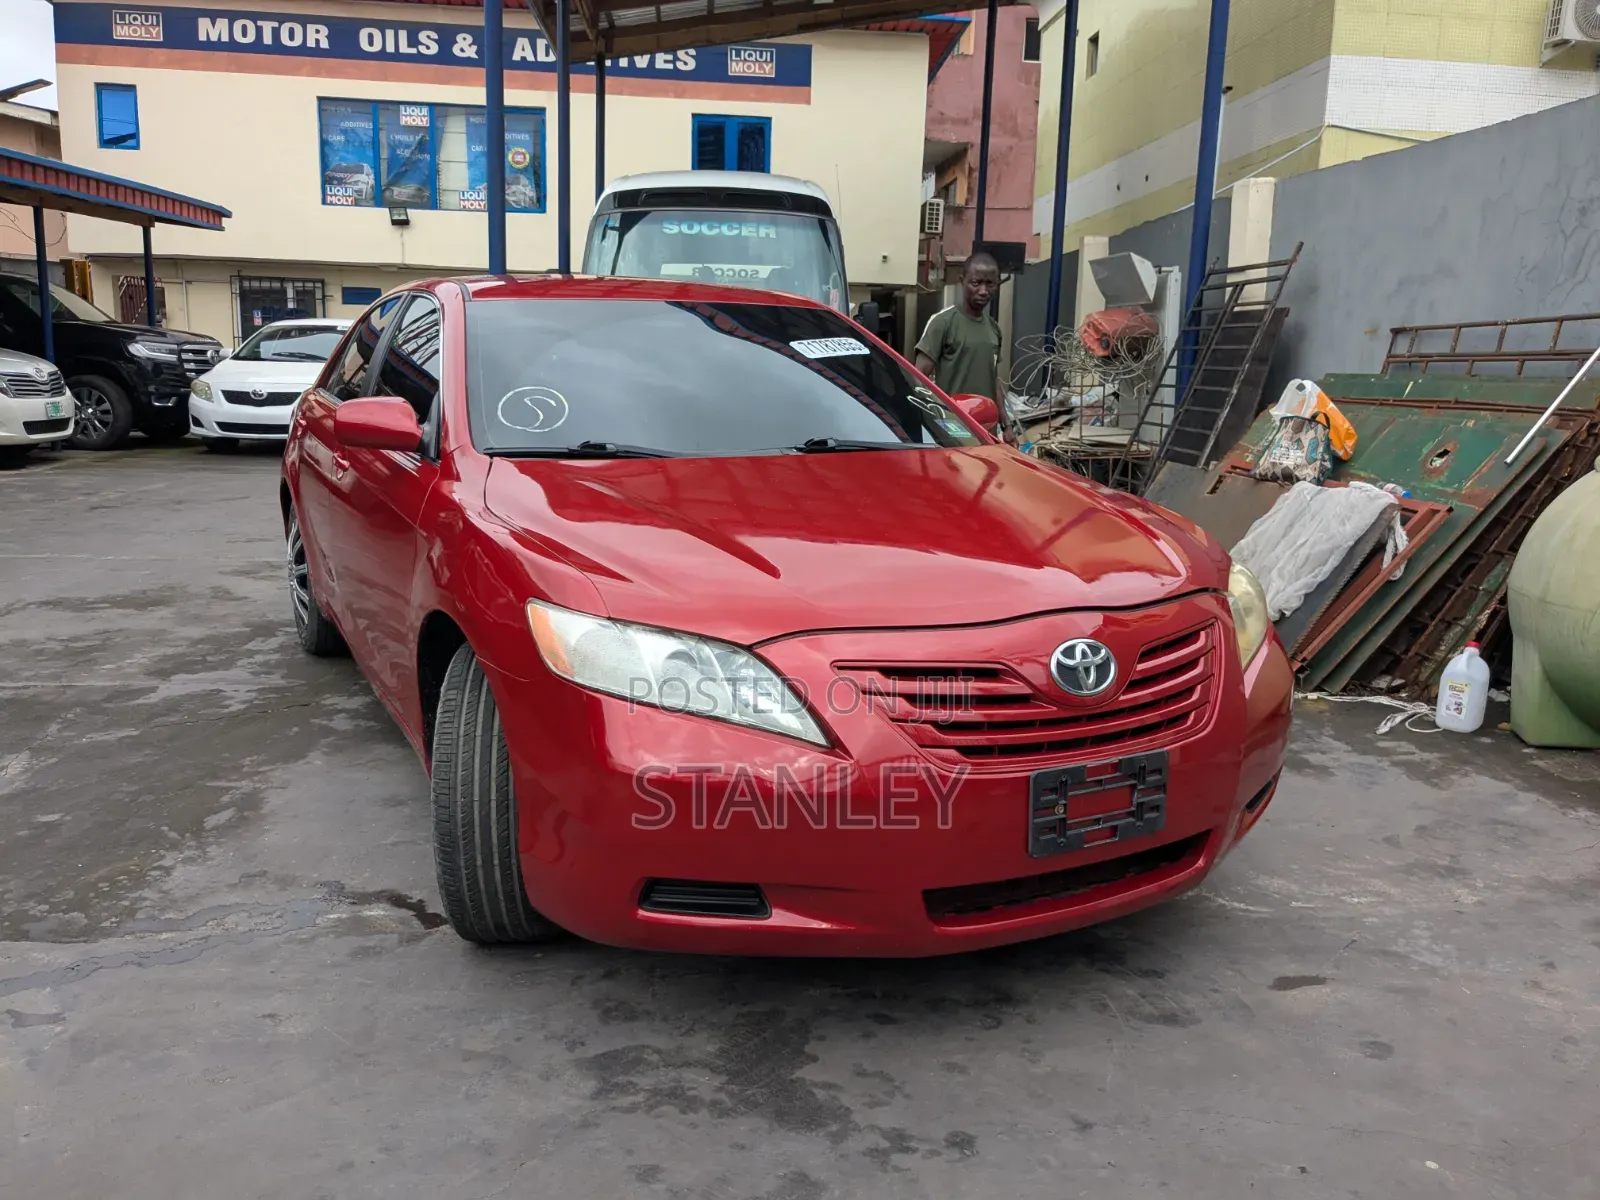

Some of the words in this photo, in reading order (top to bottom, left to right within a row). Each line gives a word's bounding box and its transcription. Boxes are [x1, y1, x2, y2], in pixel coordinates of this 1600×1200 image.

[116, 13, 158, 26] LIQUI
[116, 25, 160, 38] MOLY
[198, 17, 330, 49] MOTOR
[359, 27, 439, 55] OILS
[452, 33, 479, 59] &
[731, 49, 771, 62] LIQUI
[731, 61, 773, 74] MOLY
[402, 106, 428, 116] LIQUI
[402, 116, 428, 125] MOLY
[326, 186, 353, 196] LIQUI
[460, 191, 485, 200] LIQUI
[327, 195, 353, 205] MOLY
[460, 200, 486, 209] MOLY
[661, 219, 777, 239] SOCCER
